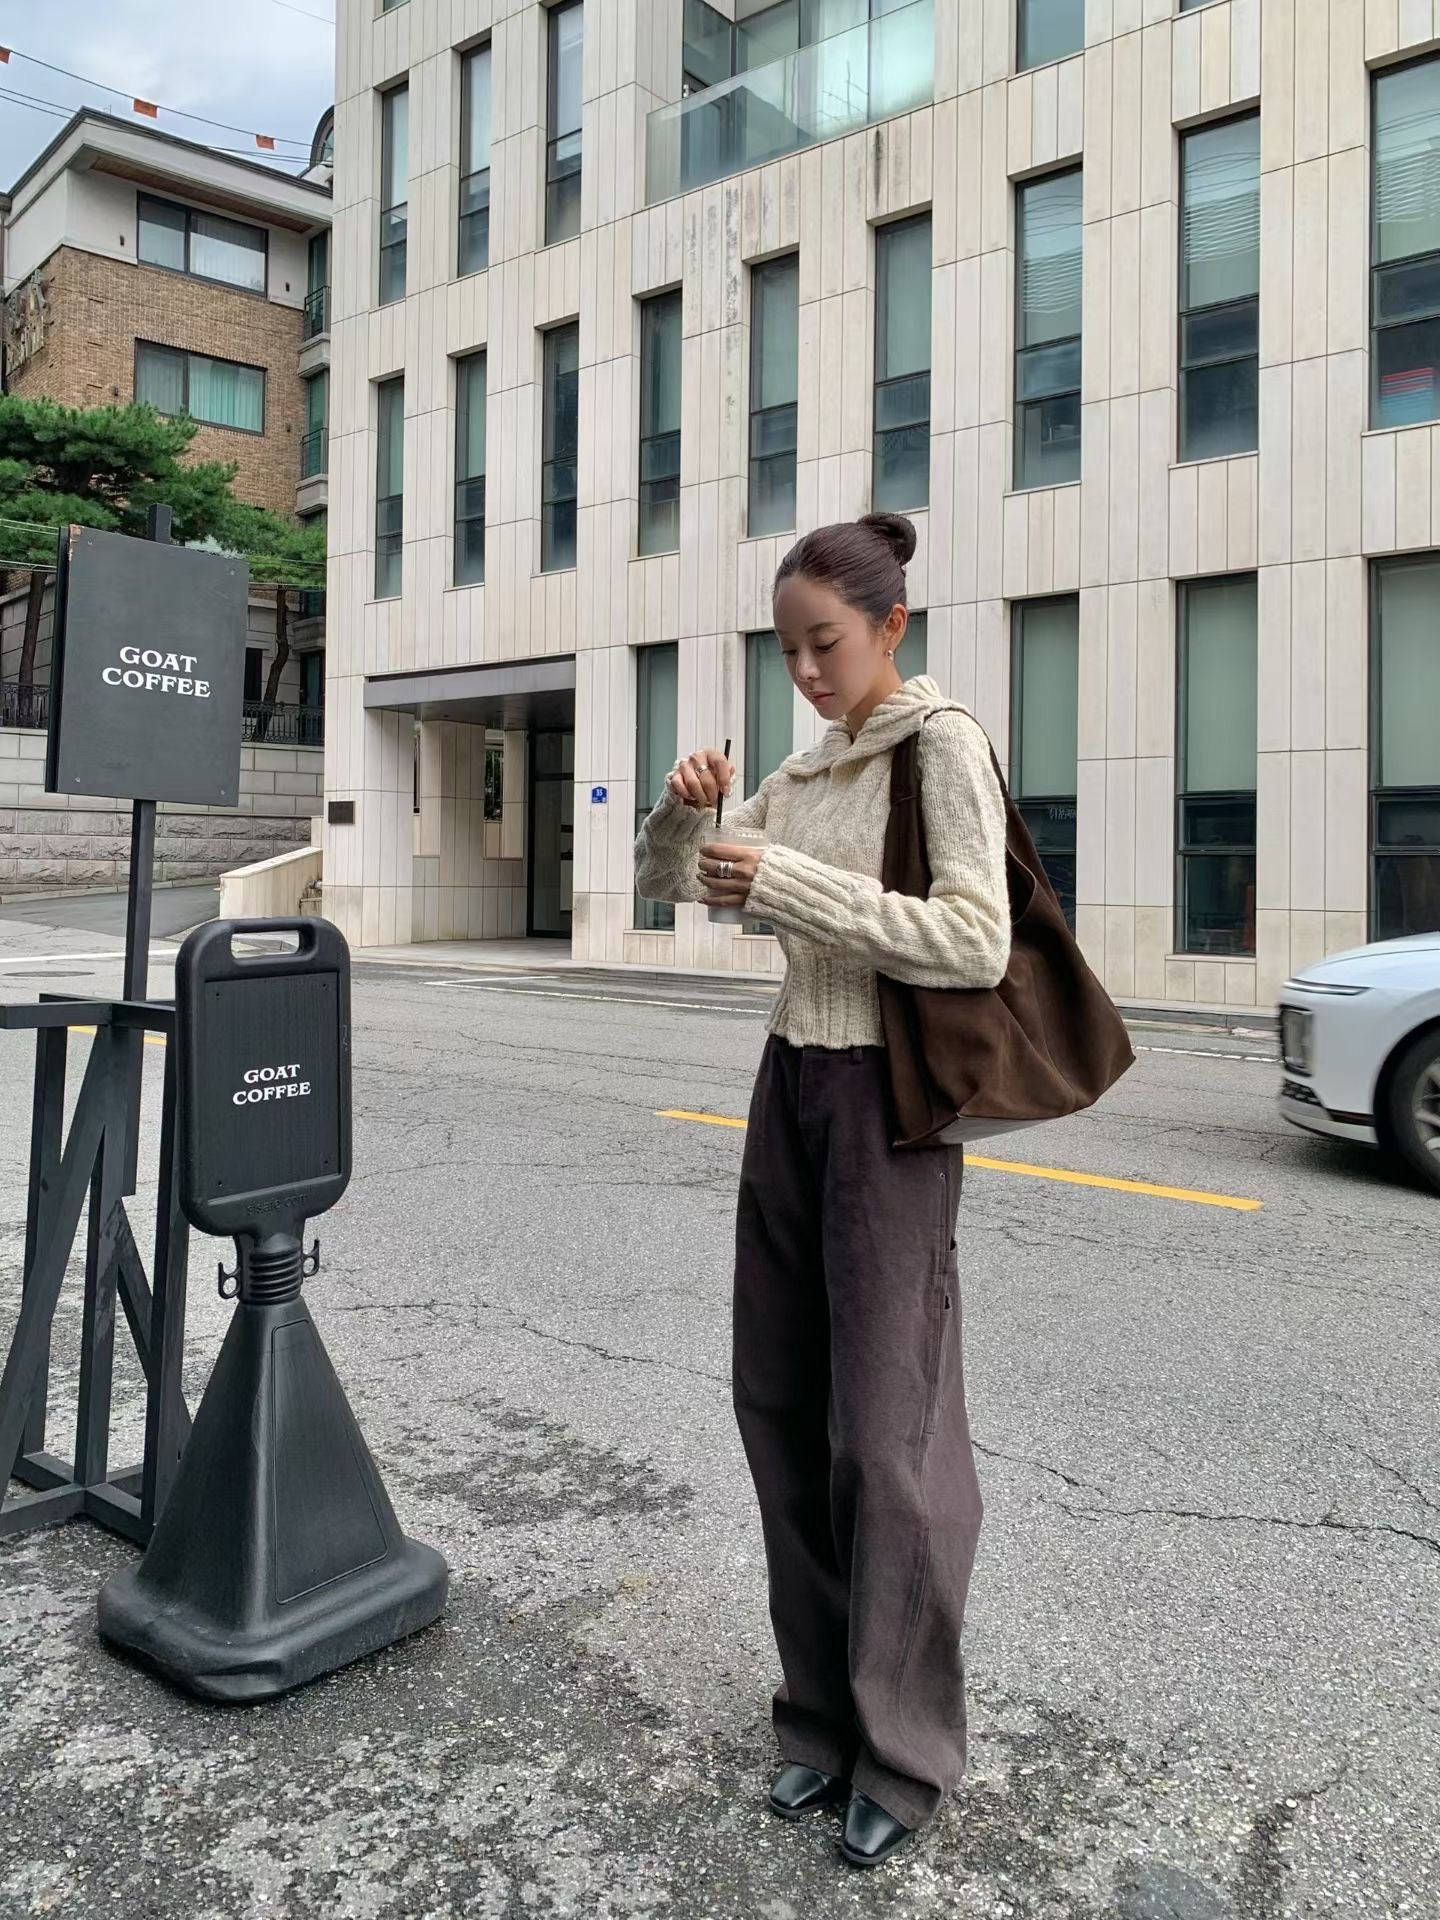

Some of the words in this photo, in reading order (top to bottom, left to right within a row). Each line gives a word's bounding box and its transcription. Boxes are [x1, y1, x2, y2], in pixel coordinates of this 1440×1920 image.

[119, 646, 198, 673] GOAT
[101, 667, 211, 698] COFFEE
[243, 1063, 301, 1084] GOAT
[232, 1081, 312, 1105] COFFEE
